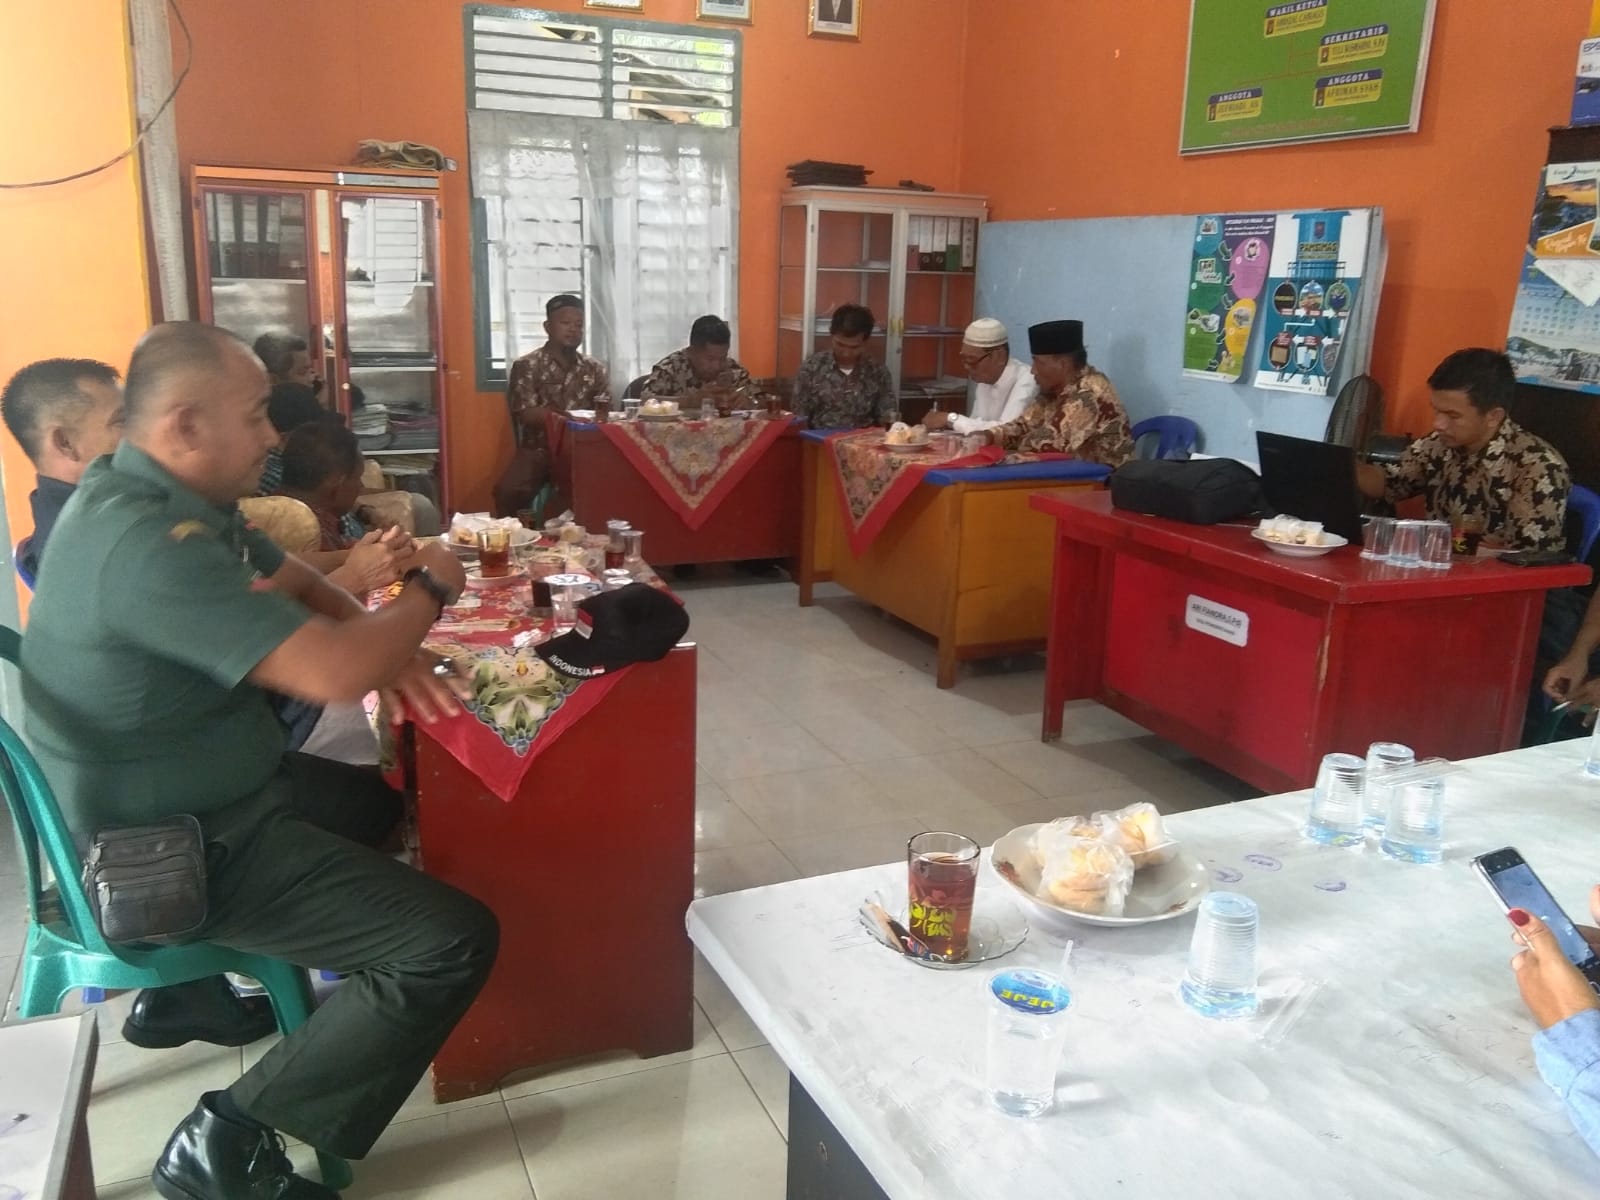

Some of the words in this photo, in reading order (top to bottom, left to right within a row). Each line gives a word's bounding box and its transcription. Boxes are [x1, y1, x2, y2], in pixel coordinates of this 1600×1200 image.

[1269, 4, 1295, 18] WAKIL
[1324, 26, 1385, 45] SEKRETARIS
[1327, 72, 1369, 86] ANGGOTA
[1217, 90, 1252, 102] ANGGOTA
[549, 654, 592, 677] INDONESIA
